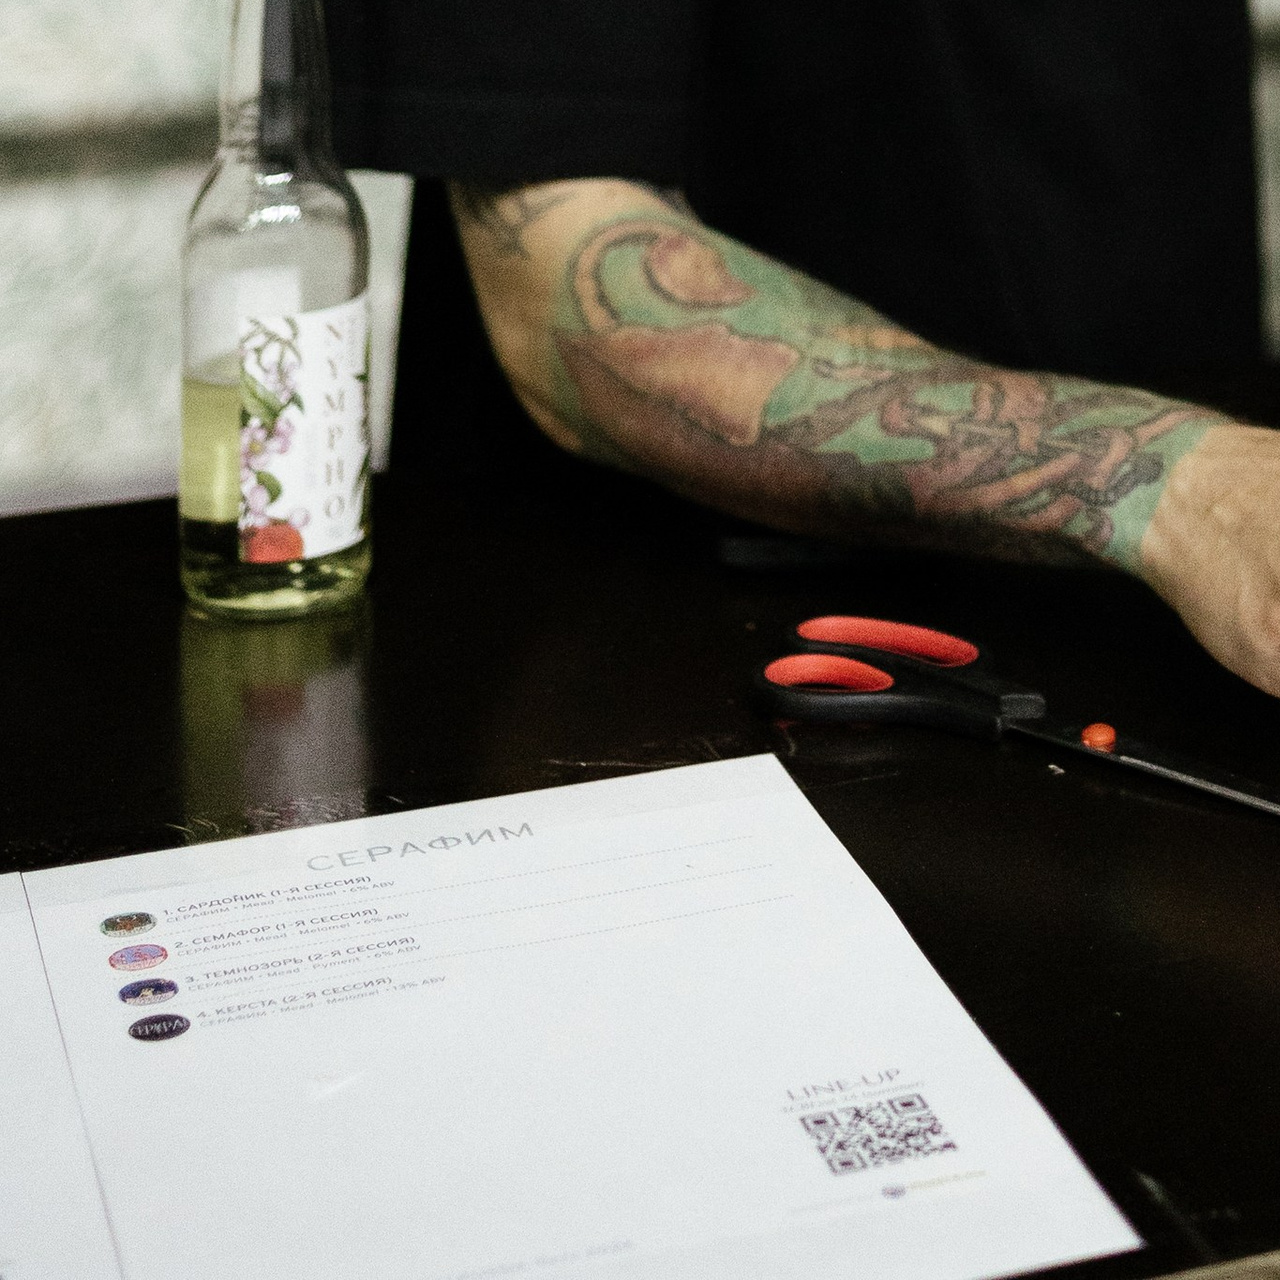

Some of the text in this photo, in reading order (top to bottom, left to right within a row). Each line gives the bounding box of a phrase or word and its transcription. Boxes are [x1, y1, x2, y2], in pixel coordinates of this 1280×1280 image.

[307, 821, 535, 872] СЕРАФИМ
[304, 875, 371, 891] СЕССИЯ)
[191, 925, 271, 944] СЕМАФОР
[309, 908, 378, 925] СЕССИЯ)
[204, 956, 302, 979] ТЕМНОЗОРЬ
[345, 936, 415, 954] СЕССИЯ)
